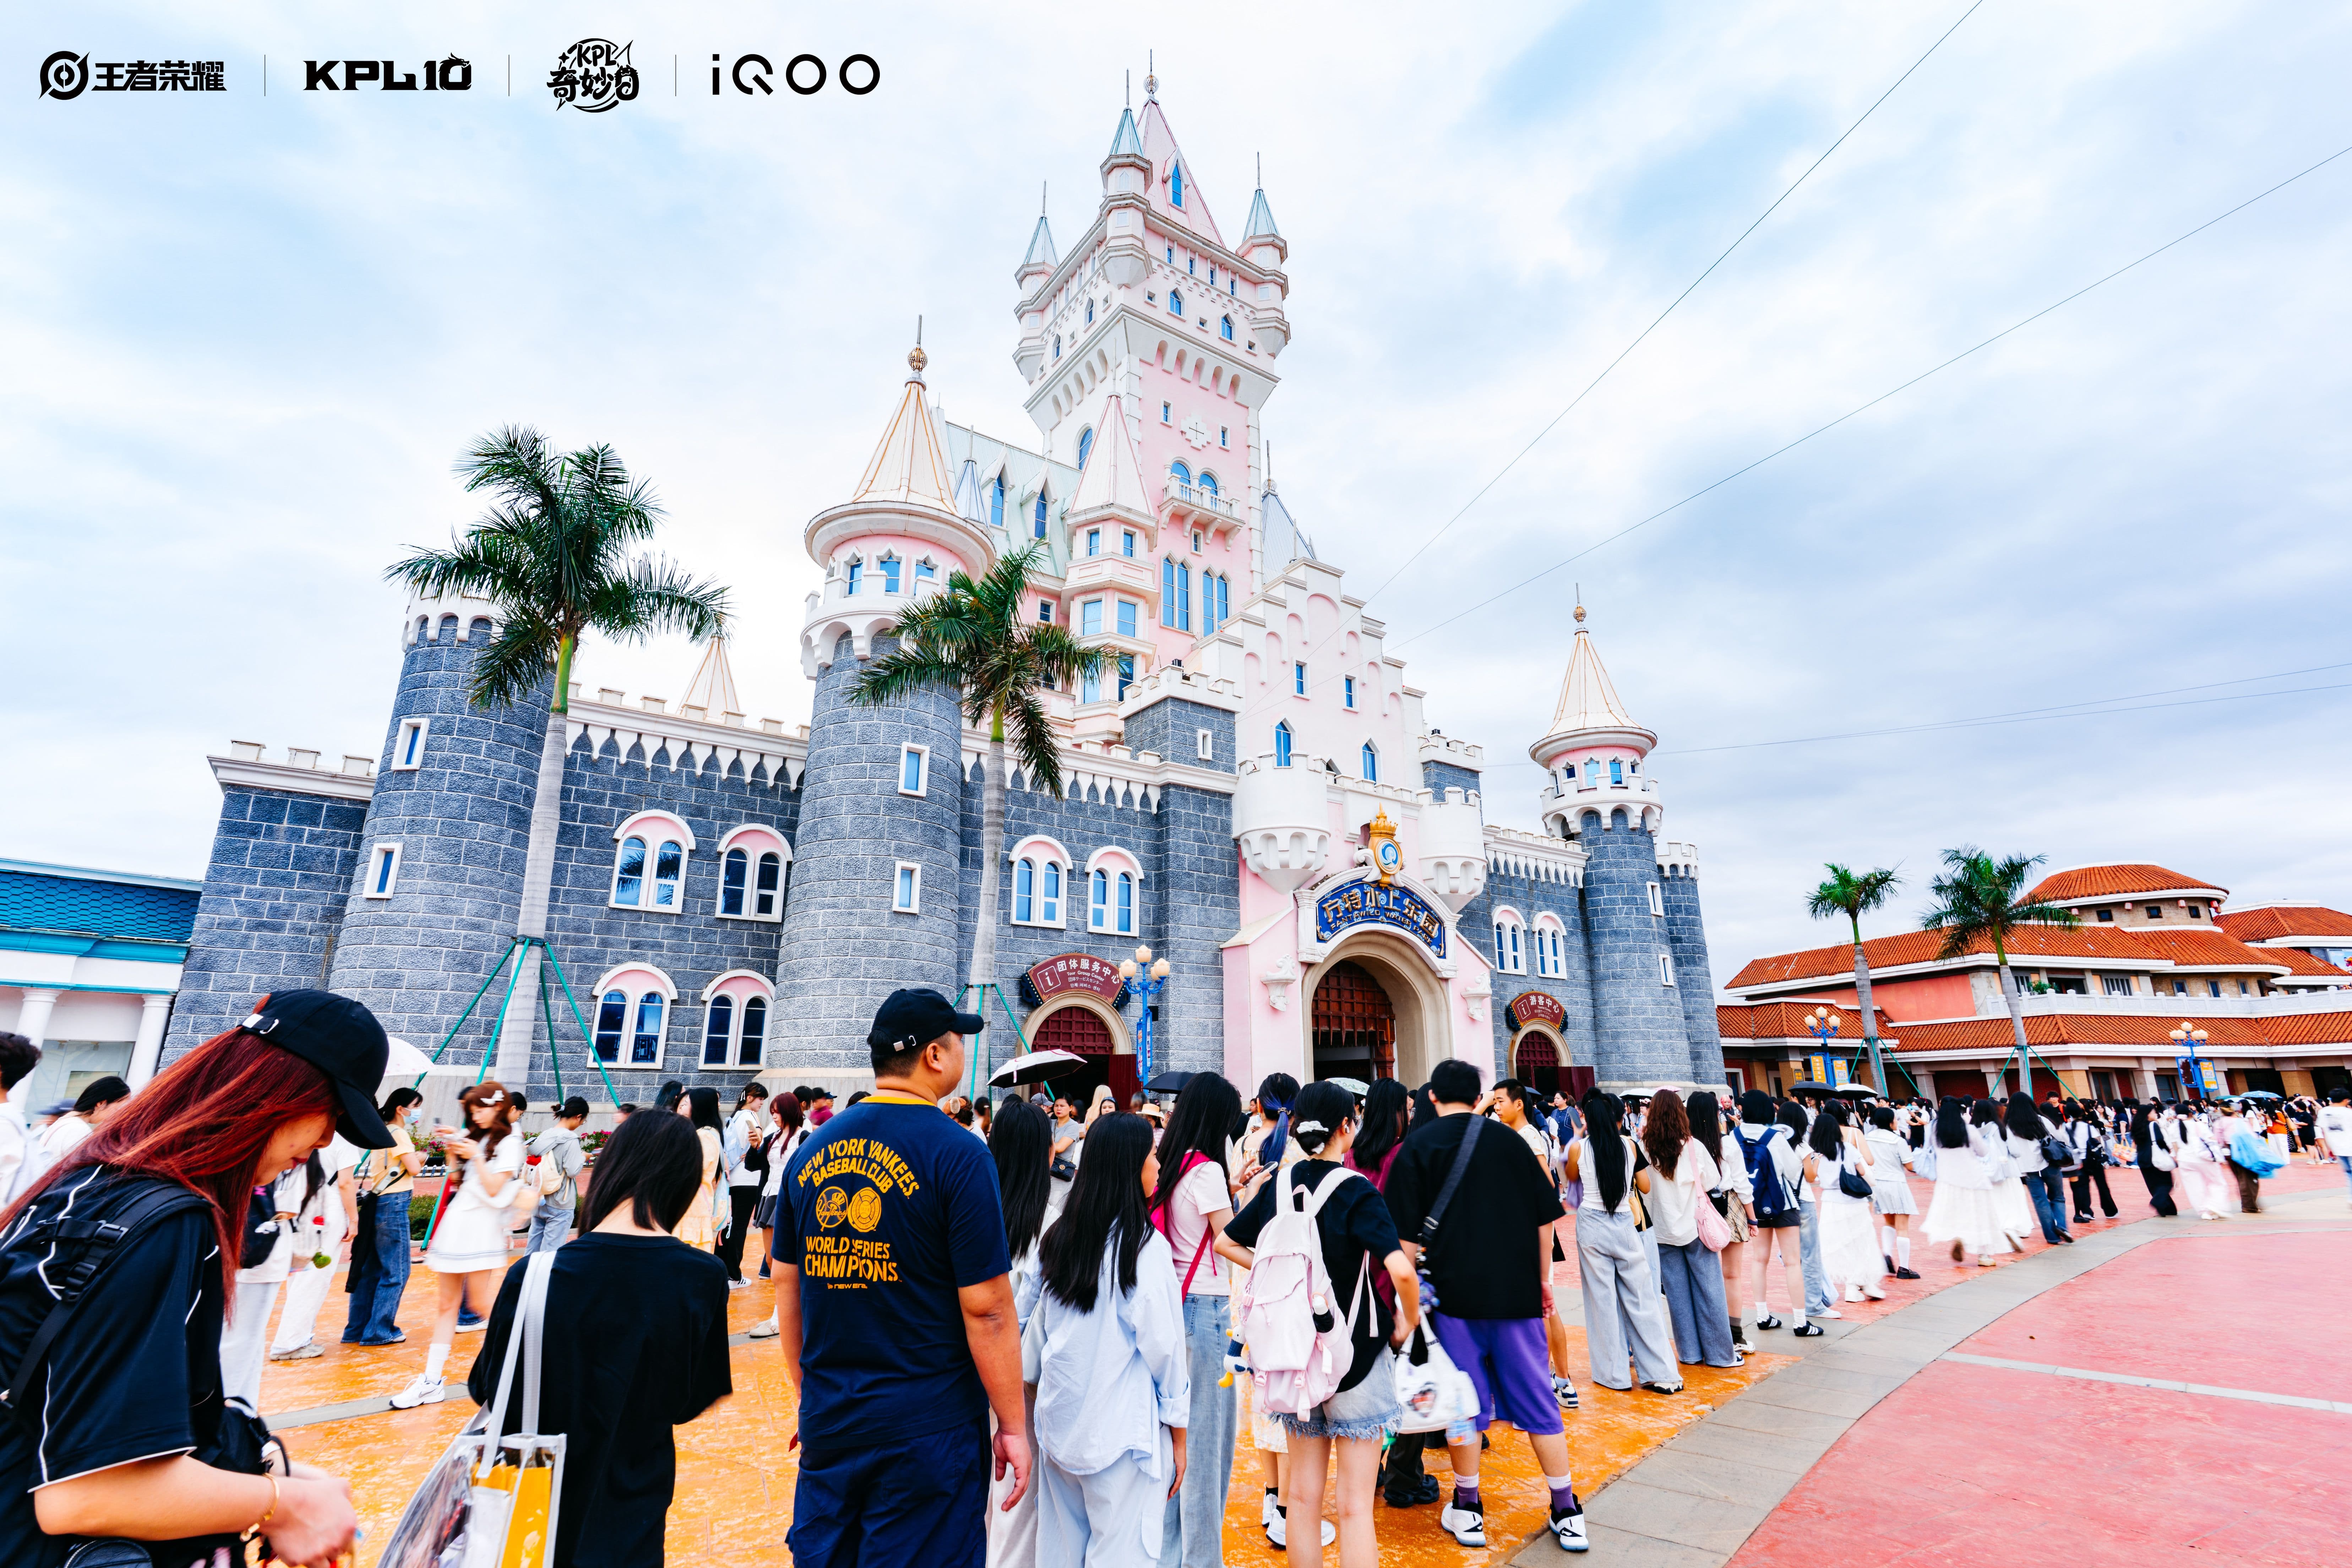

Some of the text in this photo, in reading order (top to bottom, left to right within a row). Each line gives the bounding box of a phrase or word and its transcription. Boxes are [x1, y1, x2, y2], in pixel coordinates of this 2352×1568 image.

[1322, 888, 1439, 938] 方特水上乐园
[1330, 910, 1433, 945] FANTAWILD WATER PARK
[1057, 958, 1119, 984] 团体服务中心
[1091, 973, 1105, 982] Center
[1529, 995, 1559, 1013] 游客中心
[798, 1138, 919, 1197] NEW YORK YANKEES
[812, 1158, 893, 1194] BASEBALL CLUB
[806, 1236, 891, 1259] WORLD SERIES
[805, 1253, 898, 1282] CHAMPIONS
